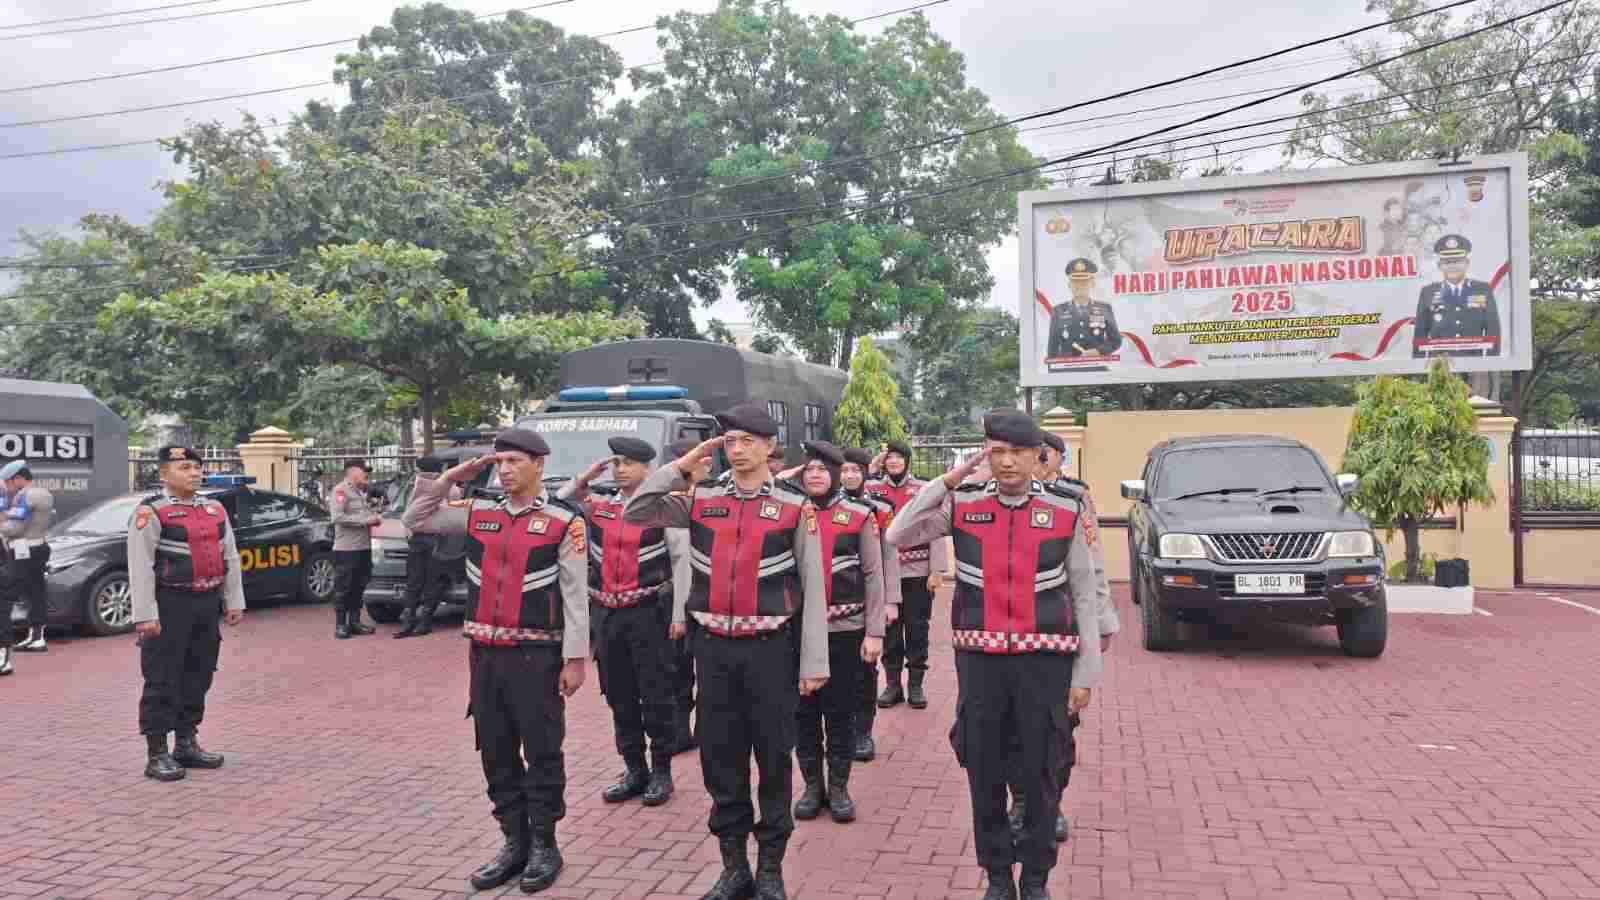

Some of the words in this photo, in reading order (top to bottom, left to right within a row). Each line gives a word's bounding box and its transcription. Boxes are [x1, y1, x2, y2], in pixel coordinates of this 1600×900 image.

[1163, 216, 1364, 264] UPACARA
[1113, 271, 1165, 295] HARI
[1169, 263, 1294, 291] PAHLAWAN
[1301, 255, 1418, 283] NASIONAL
[1231, 289, 1292, 314] 2025
[1152, 321, 1223, 335] PAHLAWANKU
[1224, 318, 1285, 332] TELADANKU
[1325, 313, 1381, 327] BERGERAK
[1189, 331, 1265, 344] MELANJUTKAN
[1267, 327, 1338, 341] PERJUANGAN
[536, 418, 577, 433] KORPS
[581, 417, 638, 433] SABHARA
[0, 433, 88, 459] OLISI
[64, 478, 88, 490] ACEH
[239, 544, 300, 571] OLISI
[1237, 575, 1250, 587] BL
